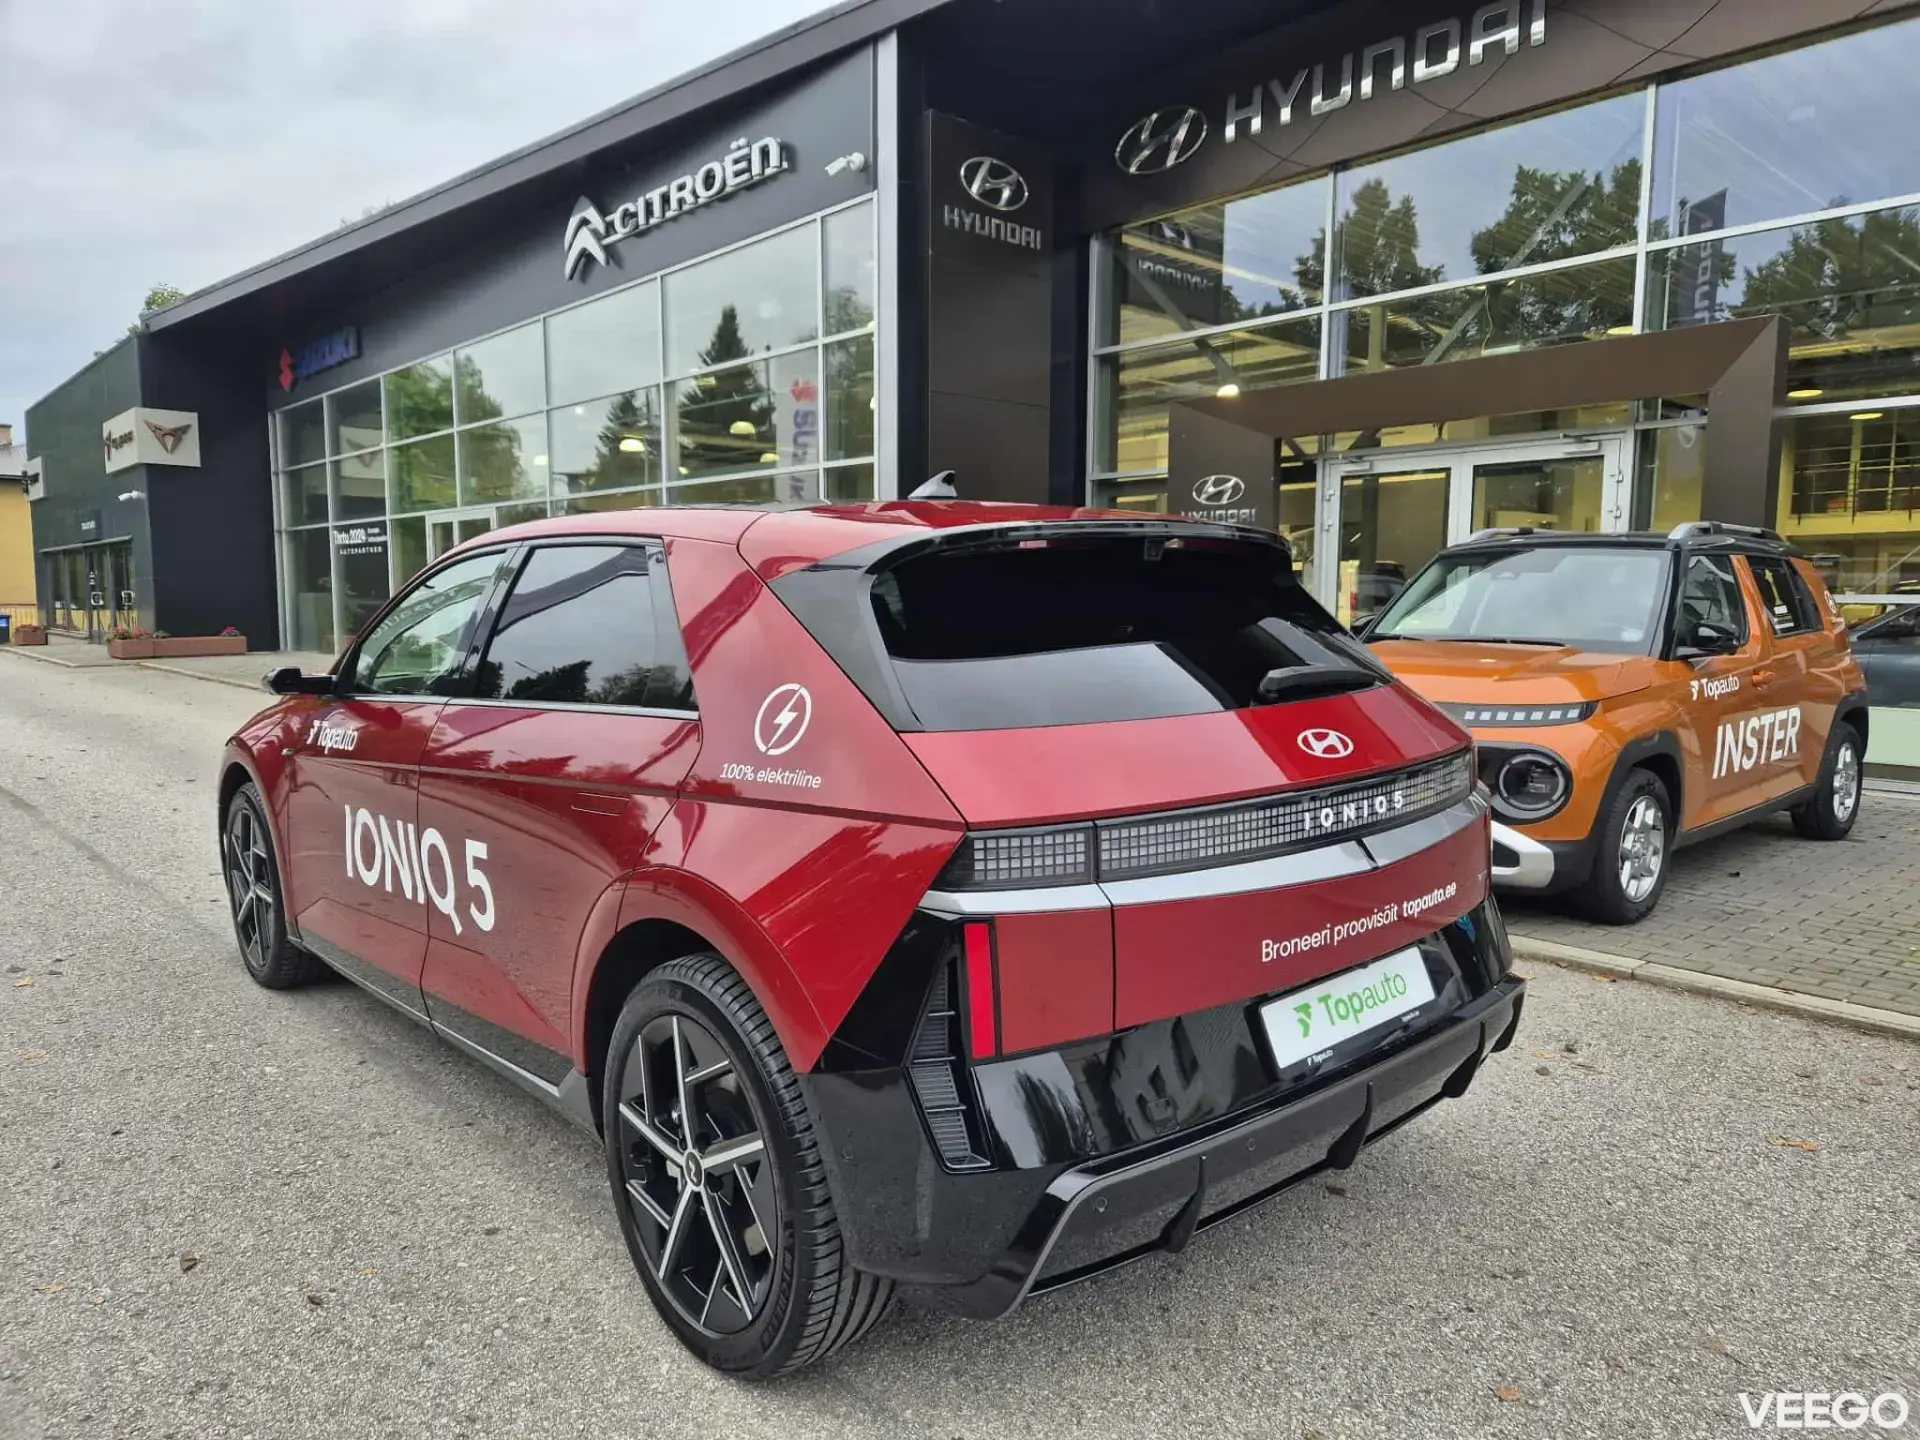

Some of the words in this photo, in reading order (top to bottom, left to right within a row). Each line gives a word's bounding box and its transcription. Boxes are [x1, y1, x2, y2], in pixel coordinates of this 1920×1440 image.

[1224, 0, 1546, 143] HYUNDAI
[944, 204, 1042, 251] HYUNDAI
[1701, 674, 1740, 701] Topauto
[317, 720, 358, 754] Topauto
[1712, 706, 1801, 780] INSTER
[719, 762, 755, 781] 100%
[756, 767, 822, 788] elektriline
[344, 804, 463, 936] IONIQ
[465, 838, 495, 931] 5
[1261, 923, 1331, 963] Broneeri
[1333, 902, 1399, 946] proovisõit
[1402, 881, 1457, 918] topauto.ee
[1317, 972, 1407, 1027] Topauto
